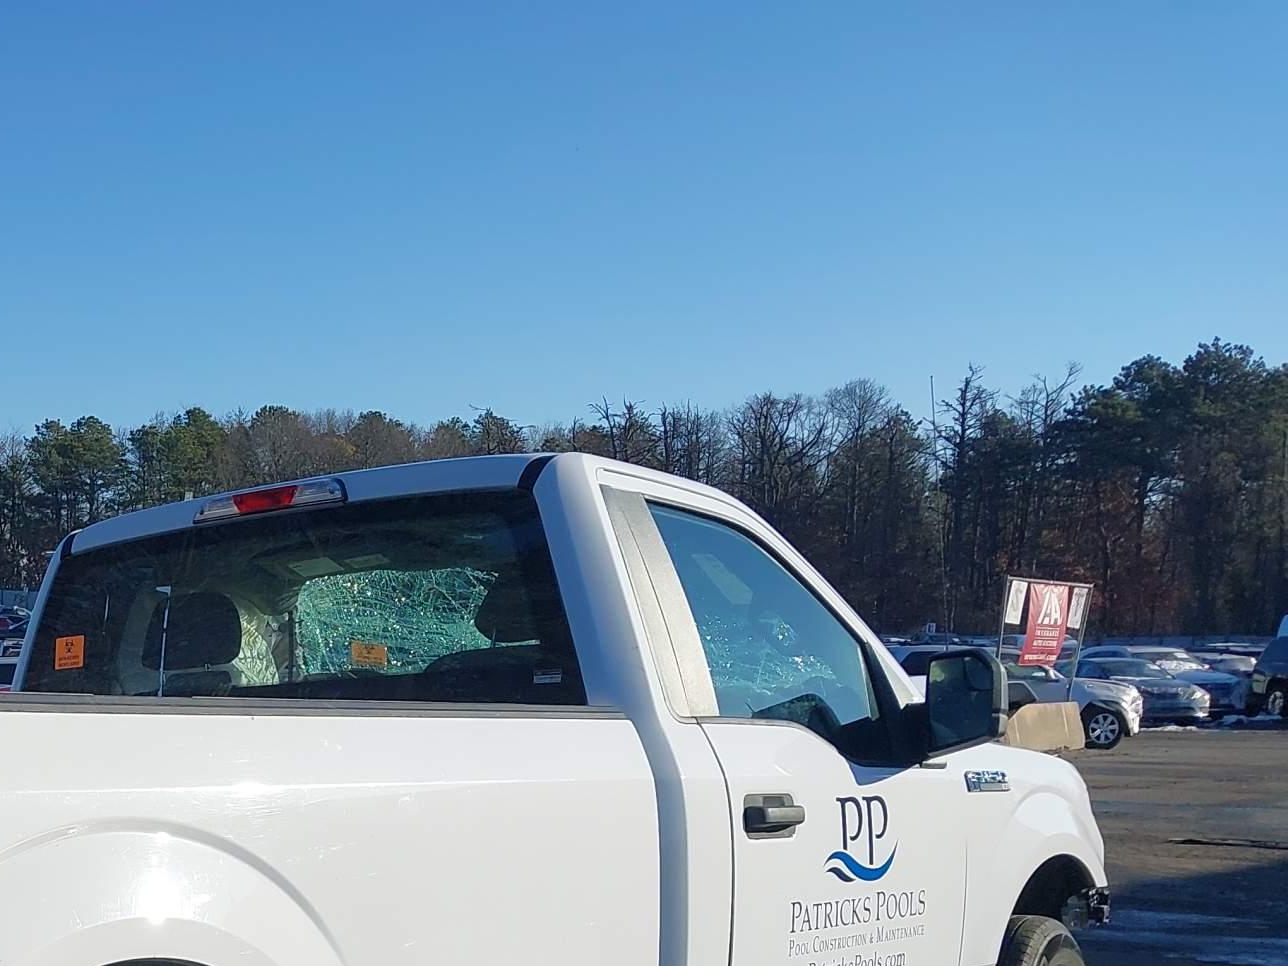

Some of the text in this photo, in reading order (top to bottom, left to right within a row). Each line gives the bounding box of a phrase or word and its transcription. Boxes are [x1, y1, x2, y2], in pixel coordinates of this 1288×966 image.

[790, 889, 927, 934] PATRICKS POOLS
[812, 932, 868, 954] CONSTRUCTION
[876, 924, 925, 944] MAINTENANCE
